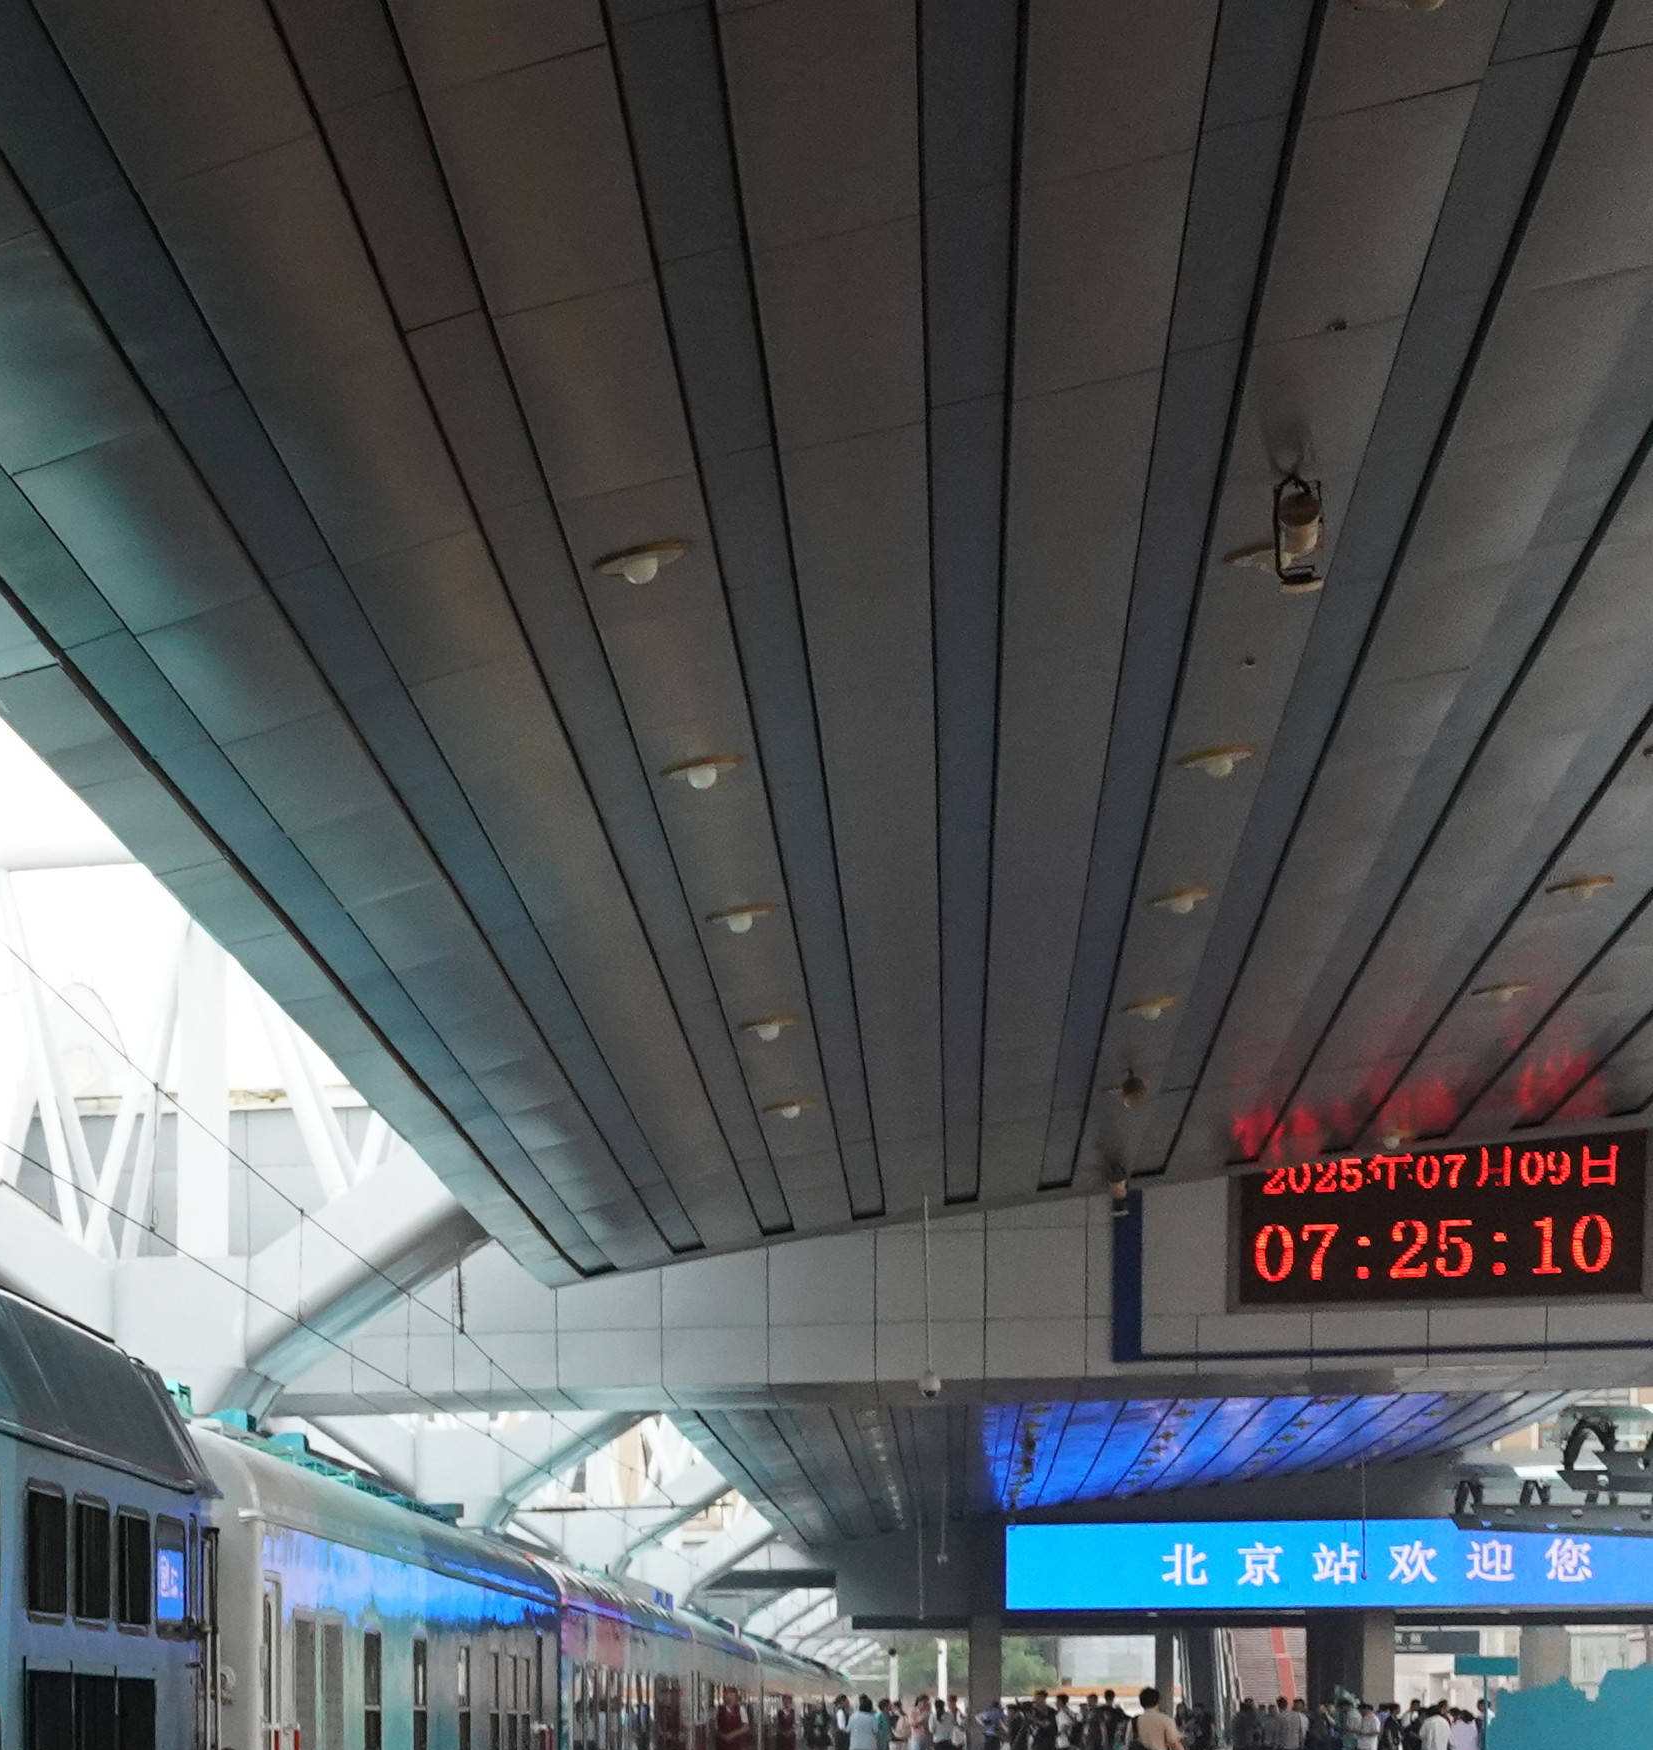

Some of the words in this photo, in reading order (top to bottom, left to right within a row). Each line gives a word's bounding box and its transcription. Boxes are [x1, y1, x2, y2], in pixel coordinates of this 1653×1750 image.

[1254, 1212, 1614, 1283] 07:25:10
[1161, 1537, 1594, 1587] 北京站欢迎您
